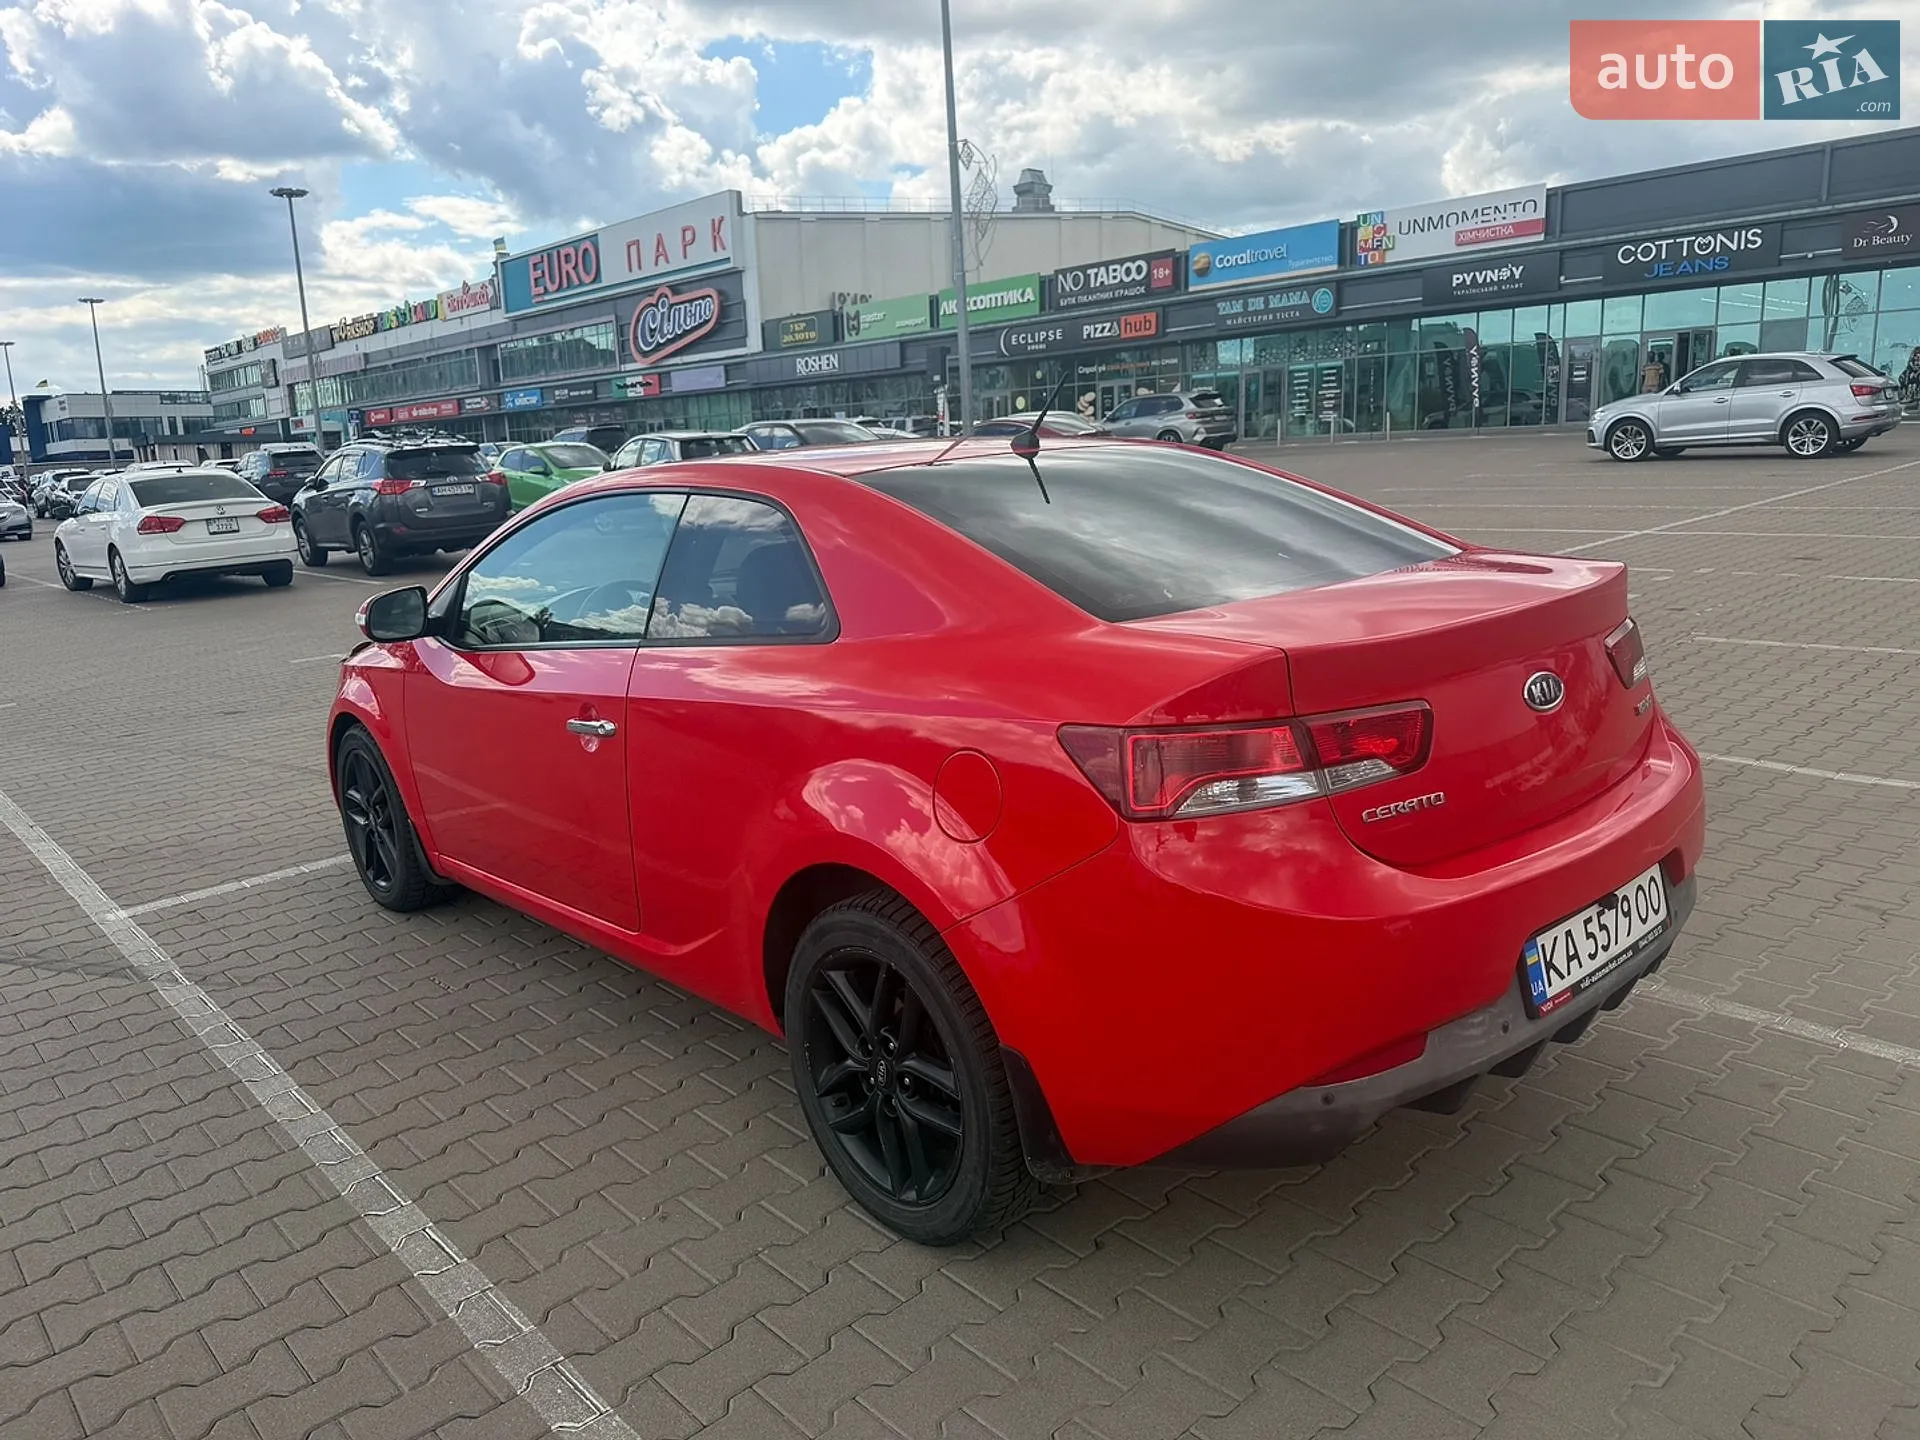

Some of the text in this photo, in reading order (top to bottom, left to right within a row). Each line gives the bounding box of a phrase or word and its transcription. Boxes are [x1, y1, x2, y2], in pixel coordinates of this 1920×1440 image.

[1360, 212, 1384, 227] UN
[1398, 198, 1537, 235] UNMOMENTO
[625, 215, 727, 274] ПАРК
[1457, 225, 1515, 243] ХІМЧИСТКА
[1617, 228, 1763, 265] COTTONIS
[1853, 233, 1914, 248] Dr Beauty
[528, 240, 598, 297] EURO
[1359, 251, 1380, 265] TO
[1644, 255, 1732, 279] JEANS
[1058, 259, 1170, 294] NO TABOO 18+
[638, 297, 714, 351] Сільпо
[1083, 315, 1153, 340] PIZZA hub
[1010, 329, 1064, 345] ECLIPSE
[796, 353, 839, 375] ROSHEN
[1531, 678, 1560, 704] KIA
[1362, 791, 1445, 823] CERATO
[1539, 929, 1584, 988] KA
[1582, 894, 1632, 961] 5579
[1530, 979, 1545, 996] UA
